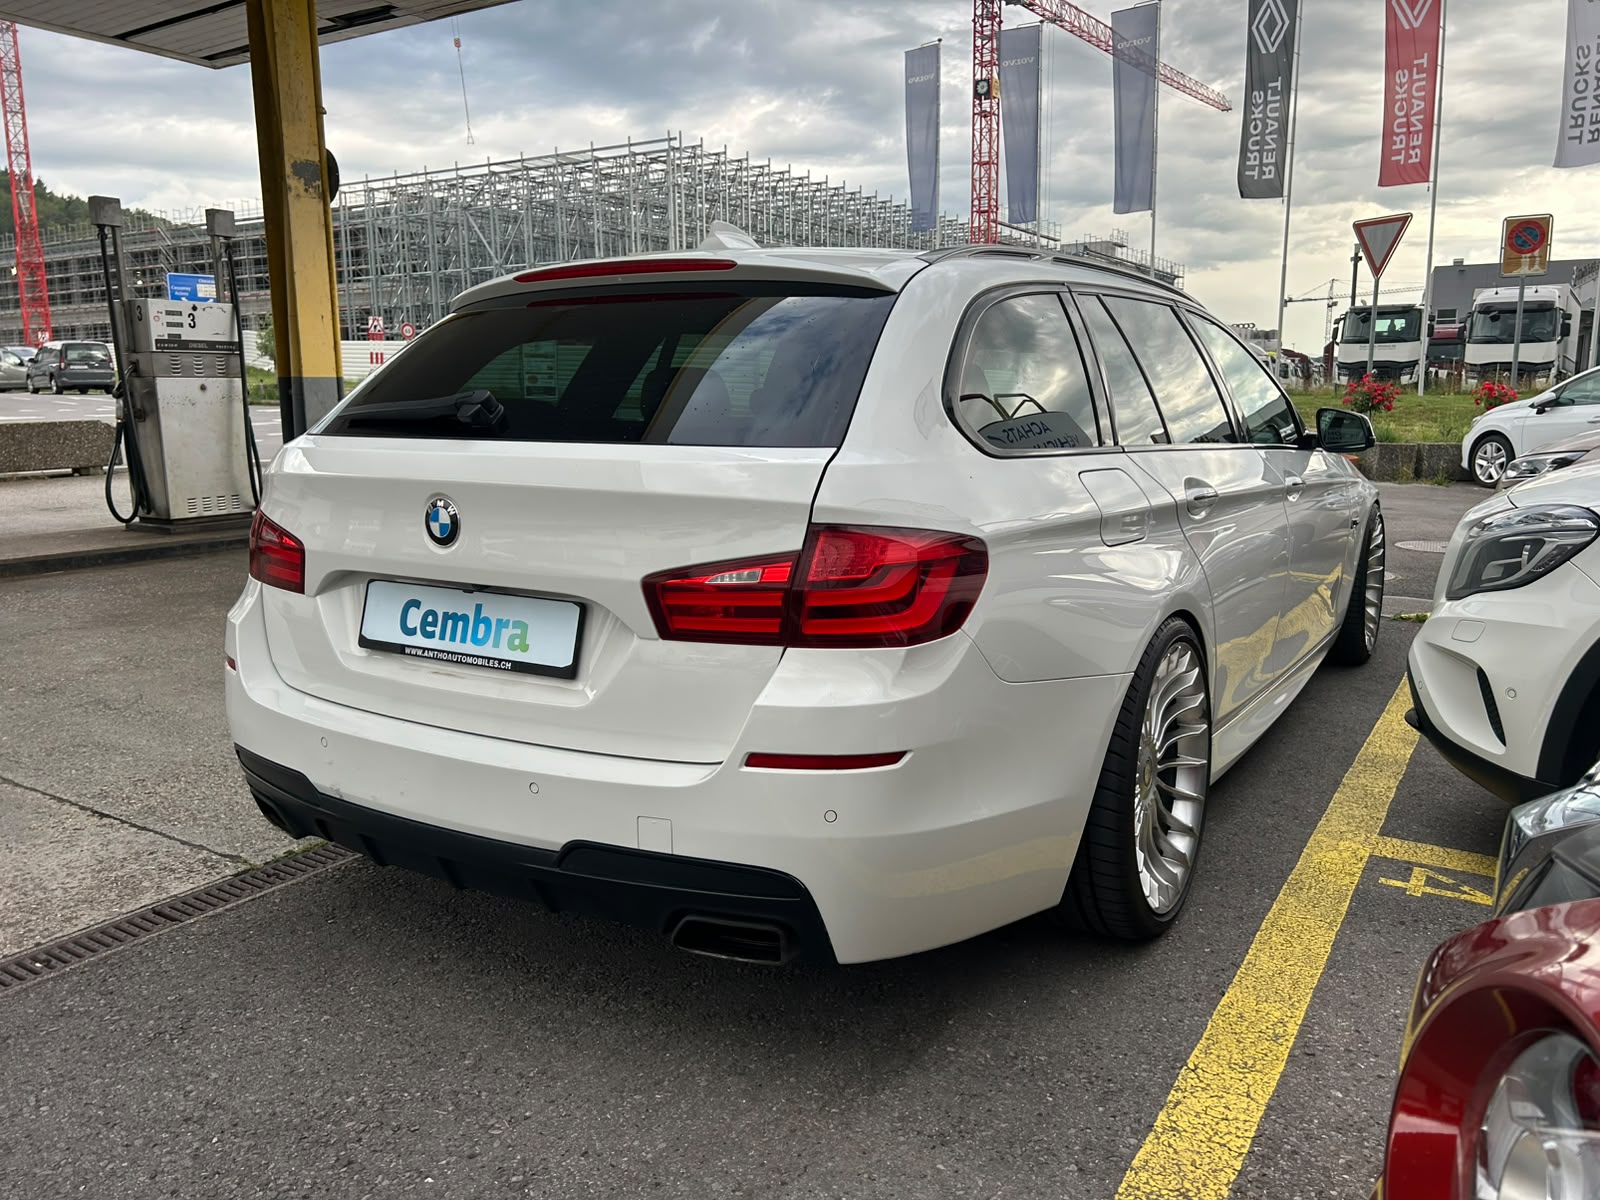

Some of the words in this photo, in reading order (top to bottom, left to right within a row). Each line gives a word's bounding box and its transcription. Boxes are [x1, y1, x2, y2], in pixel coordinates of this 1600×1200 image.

[136, 305, 143, 322] 3
[188, 313, 196, 328] 3
[427, 499, 456, 515] BMW
[399, 598, 530, 653] Cembra
[404, 646, 512, 670] WWW.ANTHOAUTOMOBILES.CH
